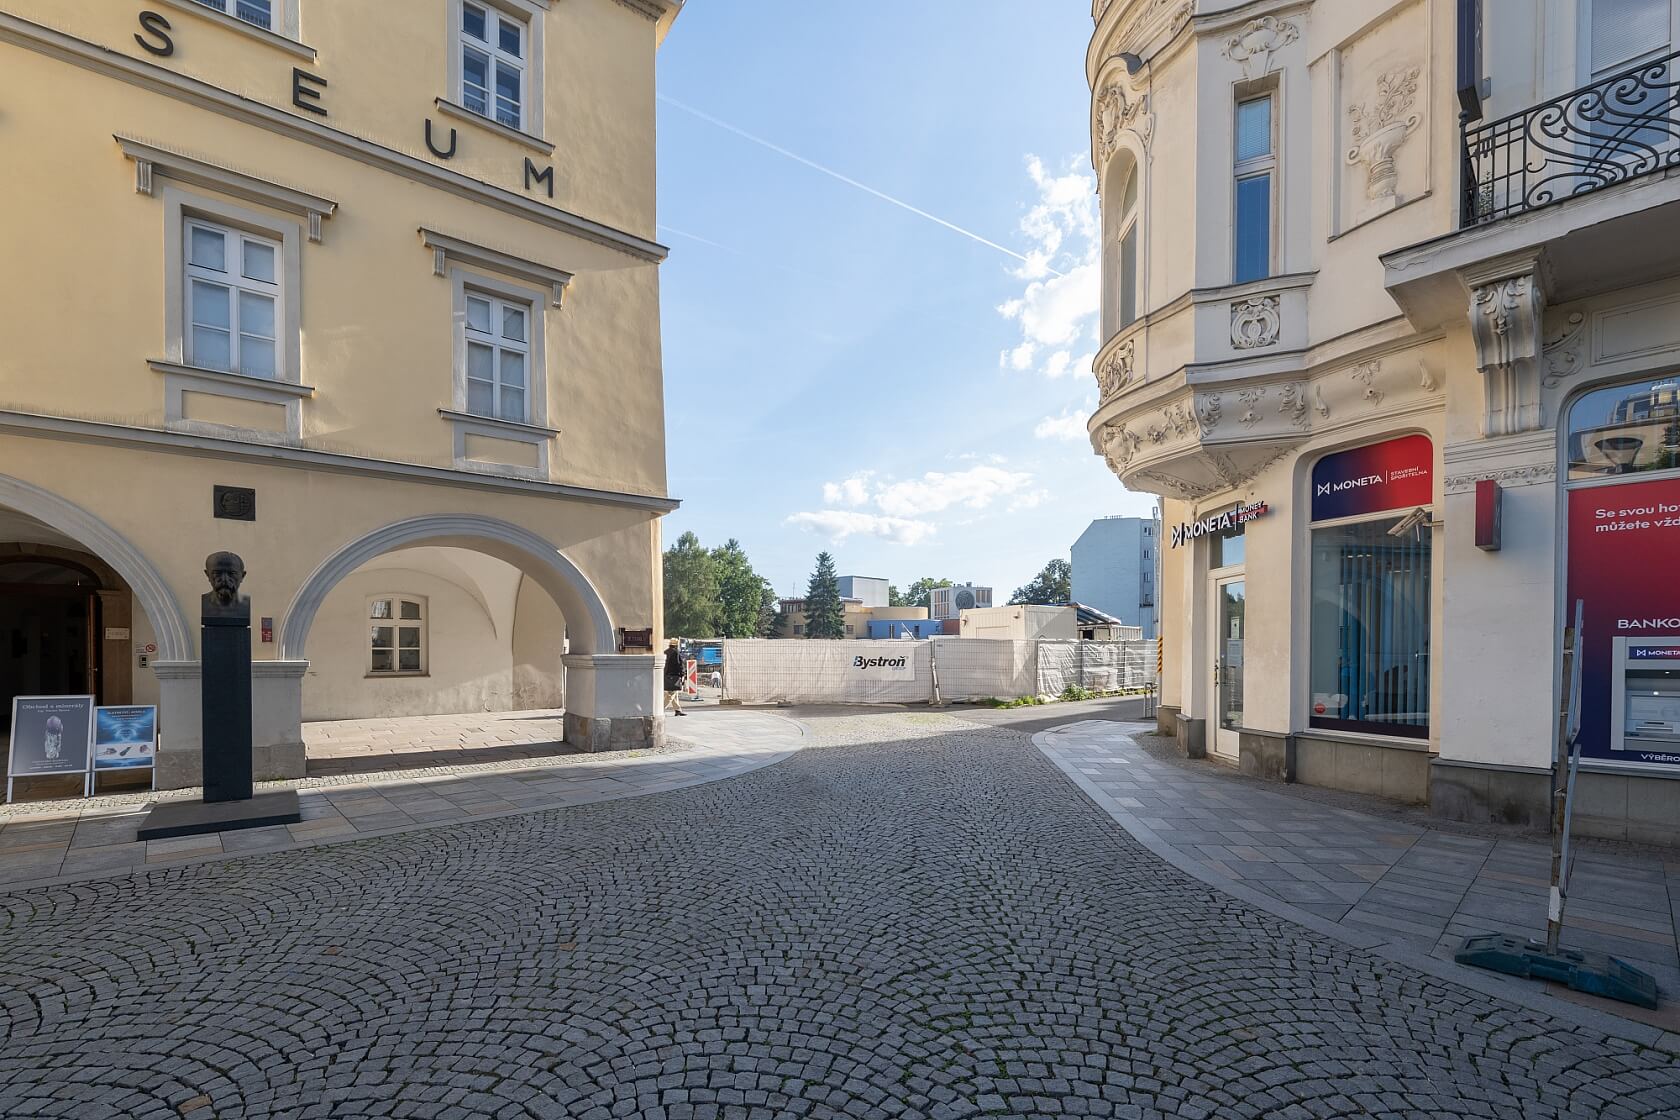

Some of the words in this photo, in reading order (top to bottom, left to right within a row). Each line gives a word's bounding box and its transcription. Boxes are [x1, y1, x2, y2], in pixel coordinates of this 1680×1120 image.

[1333, 475, 1383, 492] MONETA
[1240, 501, 1264, 513] MONEY
[1595, 509, 1616, 519] Se
[1618, 507, 1655, 517] svou
[1239, 512, 1259, 523] BANK
[1185, 512, 1232, 540] MONETA
[1595, 520, 1651, 533] můžete
[1617, 618, 1680, 629] BANKO
[852, 655, 906, 670] Bystroň
[1640, 753, 1680, 763] VÝBĚRO
